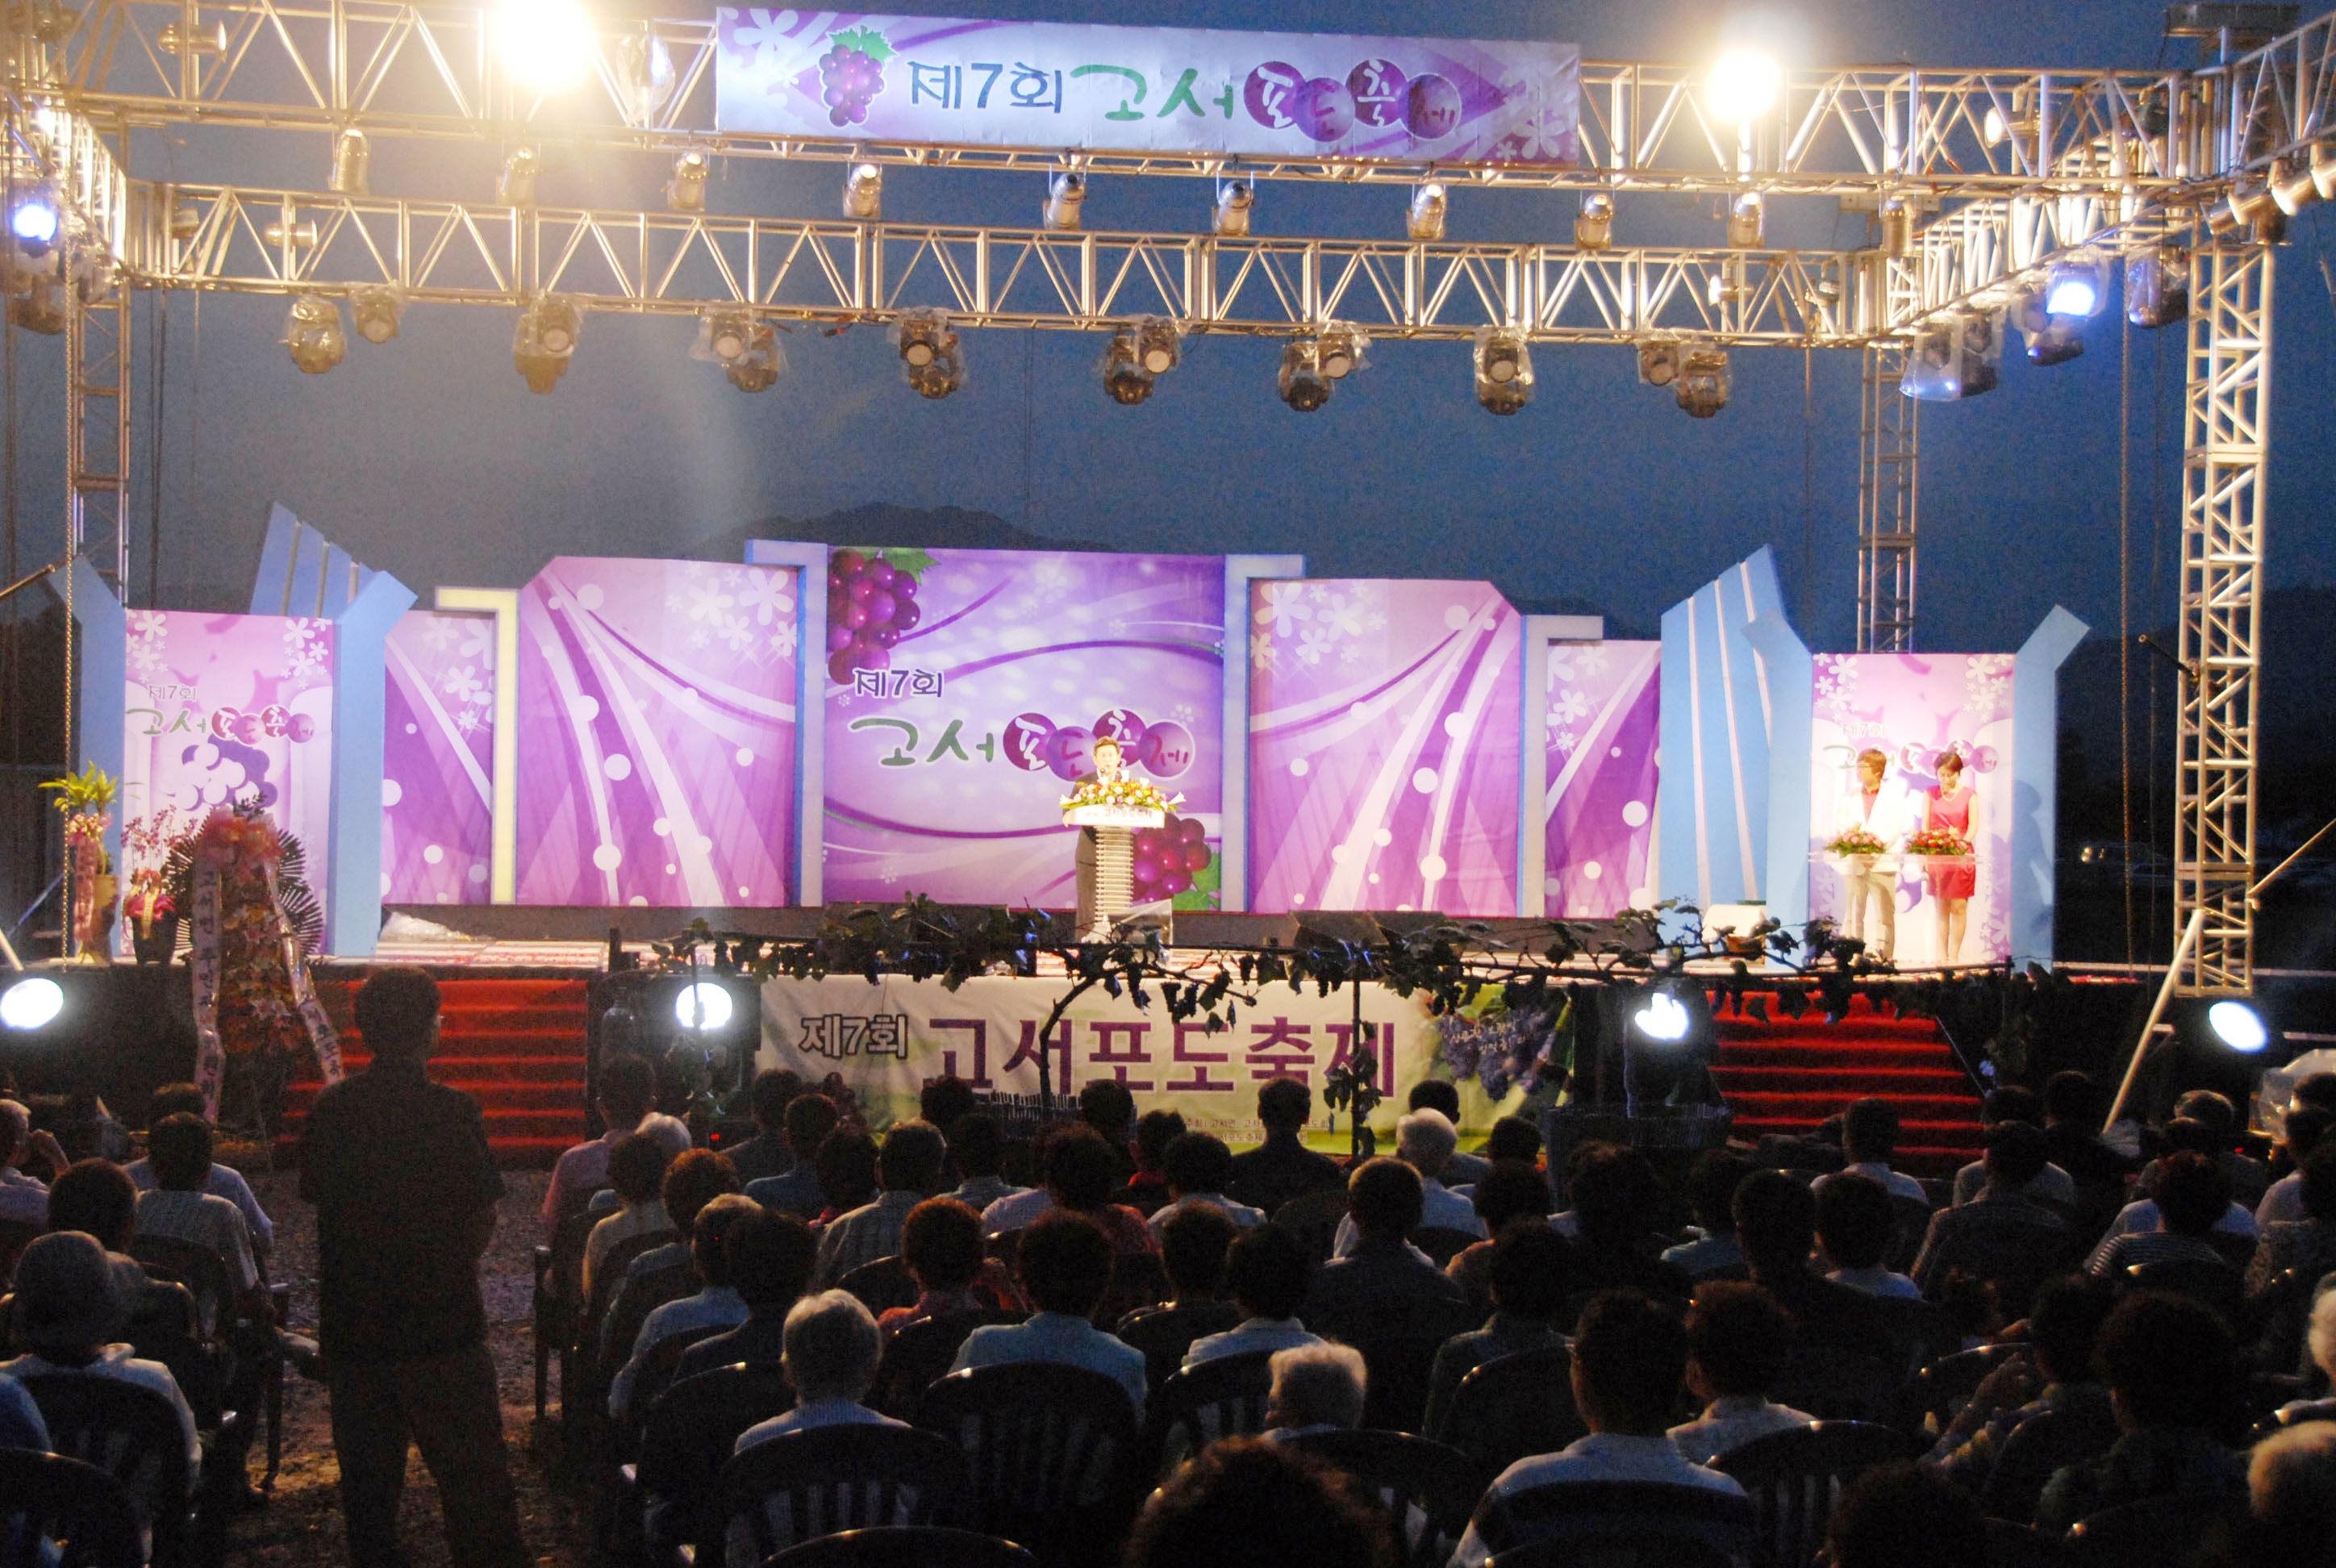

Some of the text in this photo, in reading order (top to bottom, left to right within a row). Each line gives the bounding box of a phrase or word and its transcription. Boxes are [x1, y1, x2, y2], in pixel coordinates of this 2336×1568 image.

[907, 60, 1062, 114] 제7회
[148, 685, 197, 701] 제7회
[854, 669, 943, 697] 제7회
[799, 1014, 908, 1059] 제7회
[923, 1016, 1395, 1097] 고서포도축제
